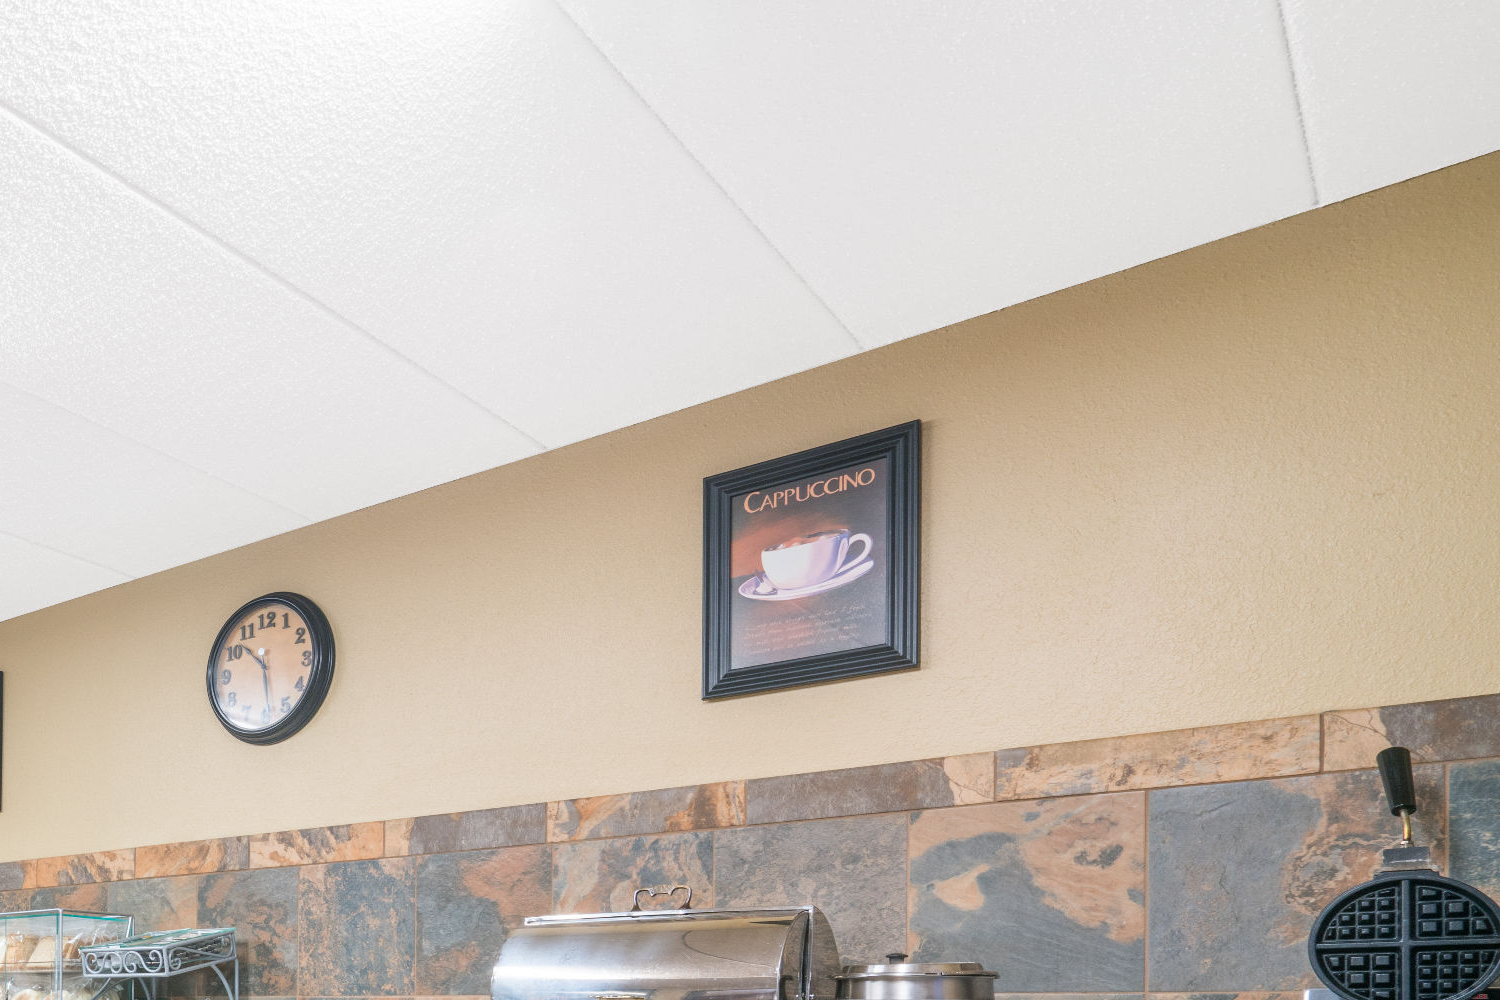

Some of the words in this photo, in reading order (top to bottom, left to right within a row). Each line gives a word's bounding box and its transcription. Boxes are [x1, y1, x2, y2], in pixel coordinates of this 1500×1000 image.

[743, 468, 876, 514] CAPPUCCINO
[257, 611, 276, 630] 12
[281, 612, 291, 629] 1
[240, 622, 256, 641] 11
[294, 627, 306, 644] 2
[226, 644, 243, 662] 10
[301, 650, 312, 667] 3
[221, 669, 232, 685] 9
[294, 675, 306, 692] 4
[228, 692, 237, 707] 8
[280, 696, 291, 713] 5
[242, 705, 252, 721] 7
